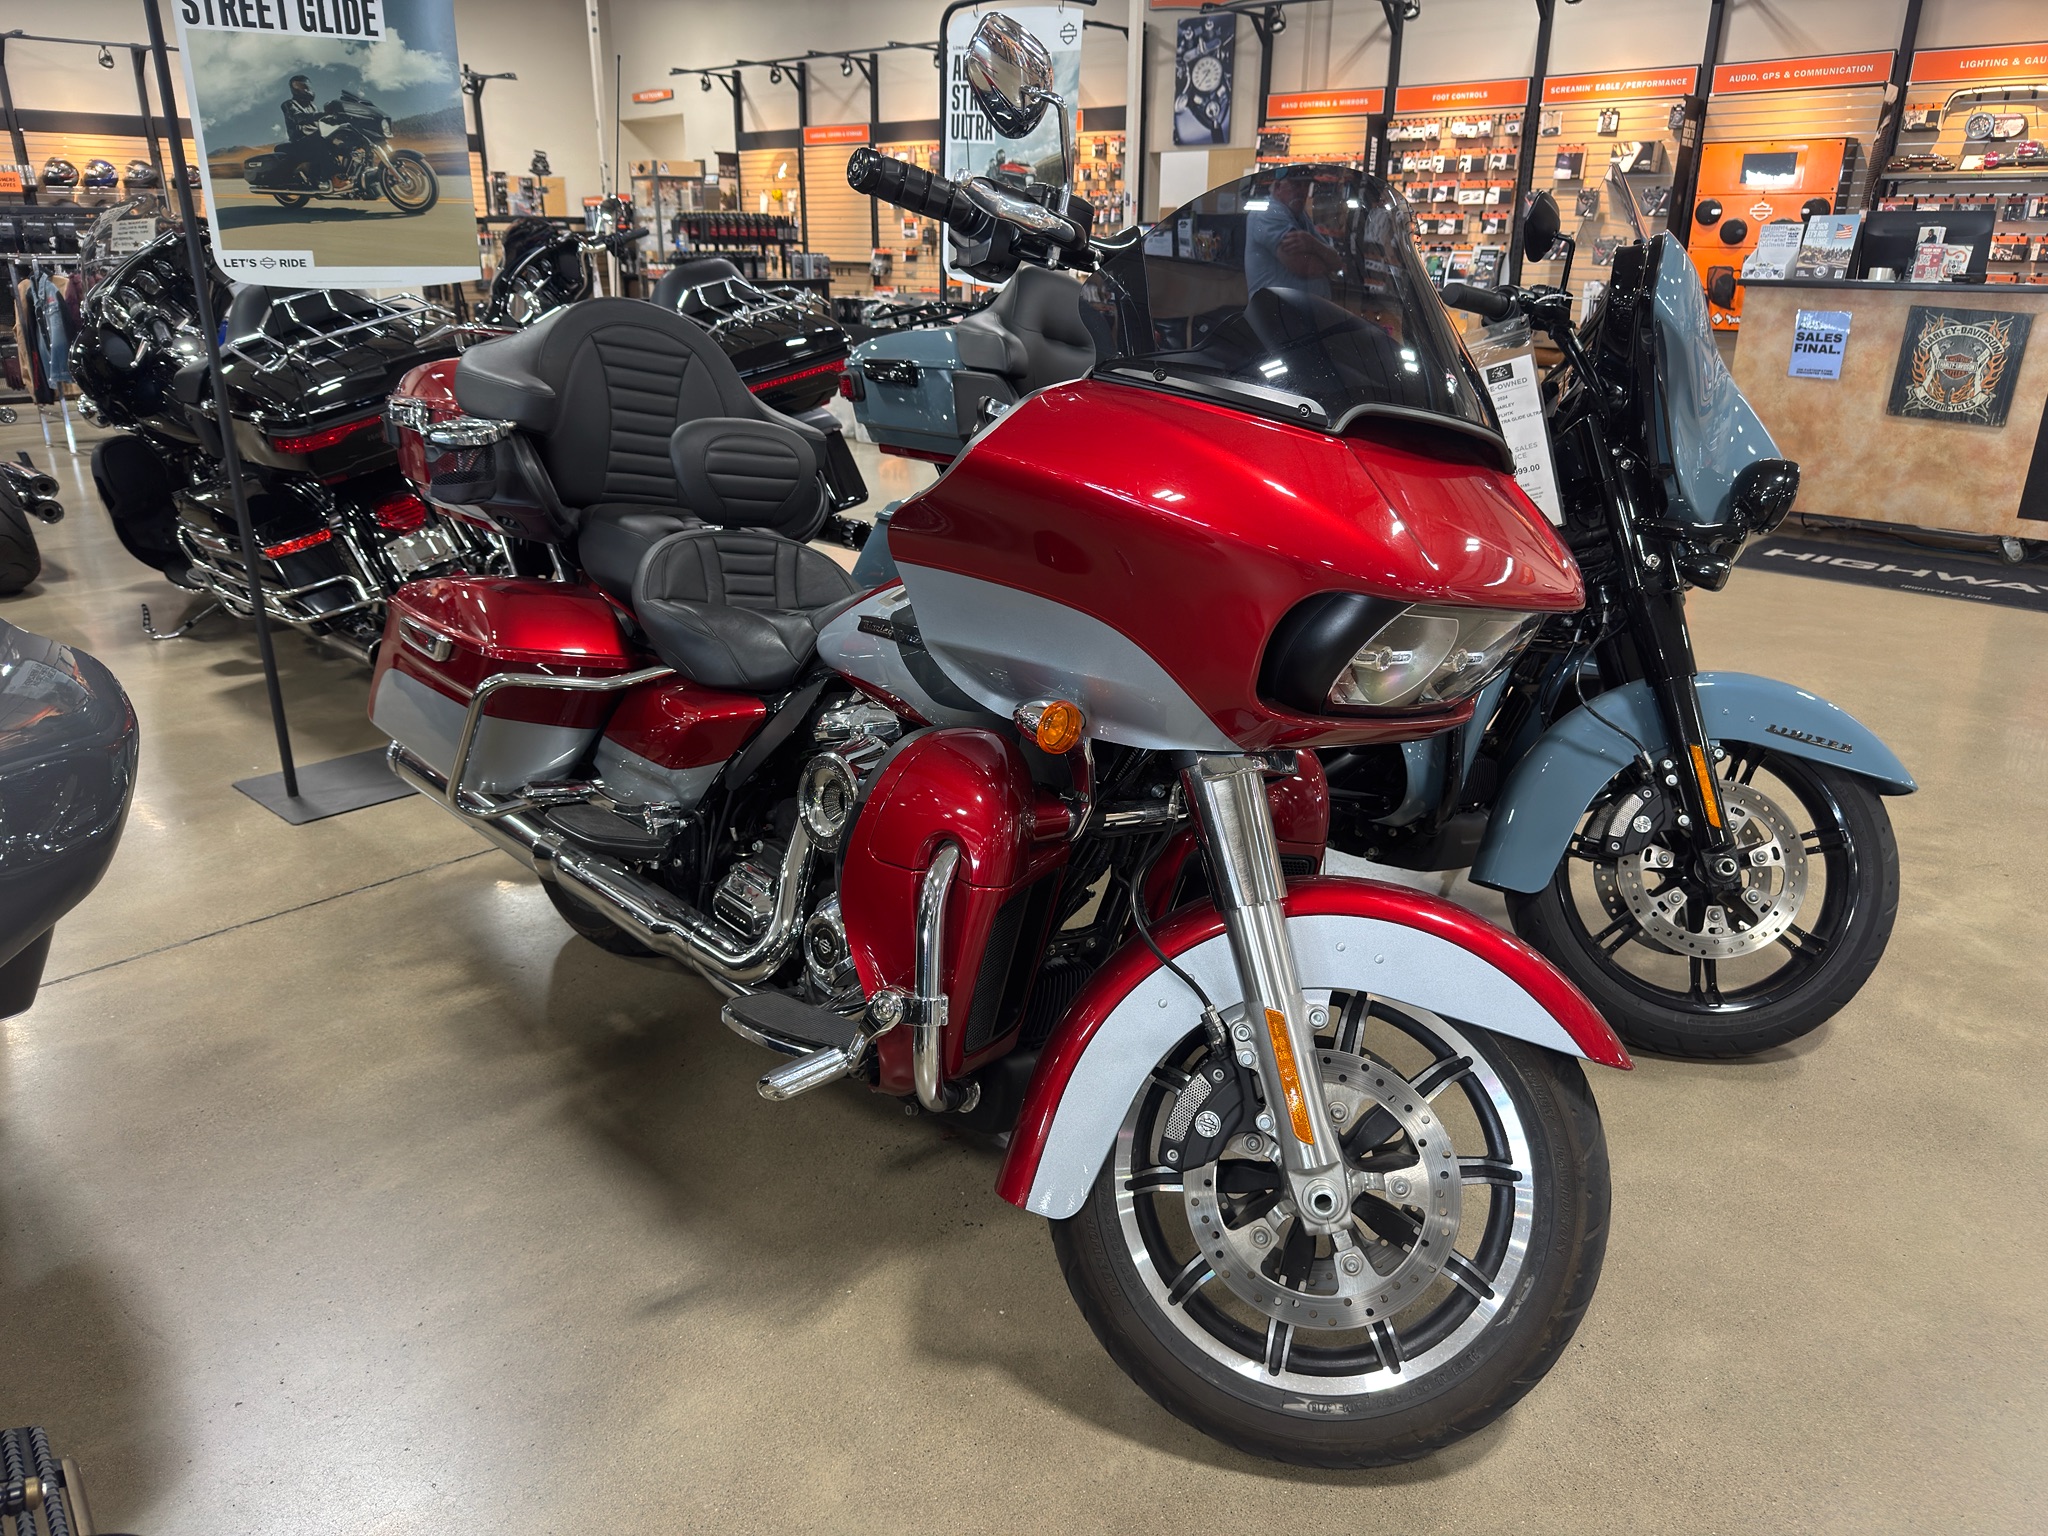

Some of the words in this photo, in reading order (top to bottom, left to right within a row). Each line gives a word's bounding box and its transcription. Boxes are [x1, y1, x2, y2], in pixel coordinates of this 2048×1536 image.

[182, 0, 288, 31] STREET
[297, 0, 379, 37] GLIDE
[1960, 58, 2009, 69] LIGHTING
[2012, 57, 2020, 66] &
[2024, 56, 2048, 65] GAU
[1729, 73, 1759, 83] AUDIO,
[1762, 71, 1781, 80] GPS
[1783, 70, 1791, 79] &
[1793, 64, 1874, 78] COMMUNICATION
[1550, 84, 1594, 94] SCREAMIN'
[1432, 93, 1450, 102] FOOT
[1451, 91, 1488, 100] CONTROLS
[1281, 101, 1298, 110] HAND
[1299, 100, 1331, 108] CONTROLS
[1332, 99, 1338, 107] &
[1339, 97, 1369, 107] MIRRORS
[951, 113, 994, 141] ULTRA
[223, 258, 257, 268] LET'S
[279, 258, 307, 268] RIDE
[1796, 331, 1843, 343] SALES
[1920, 326, 2002, 354] HARLEY-DAVIDSON
[1794, 343, 1841, 354] FINAL.
[1488, 377, 1528, 392] E-OWNED
[1921, 395, 1976, 412] MOTORCYCLES
[1514, 442, 1538, 453] SALES
[1515, 463, 1540, 476] 999.00
[1762, 548, 2048, 595] HIGHWA
